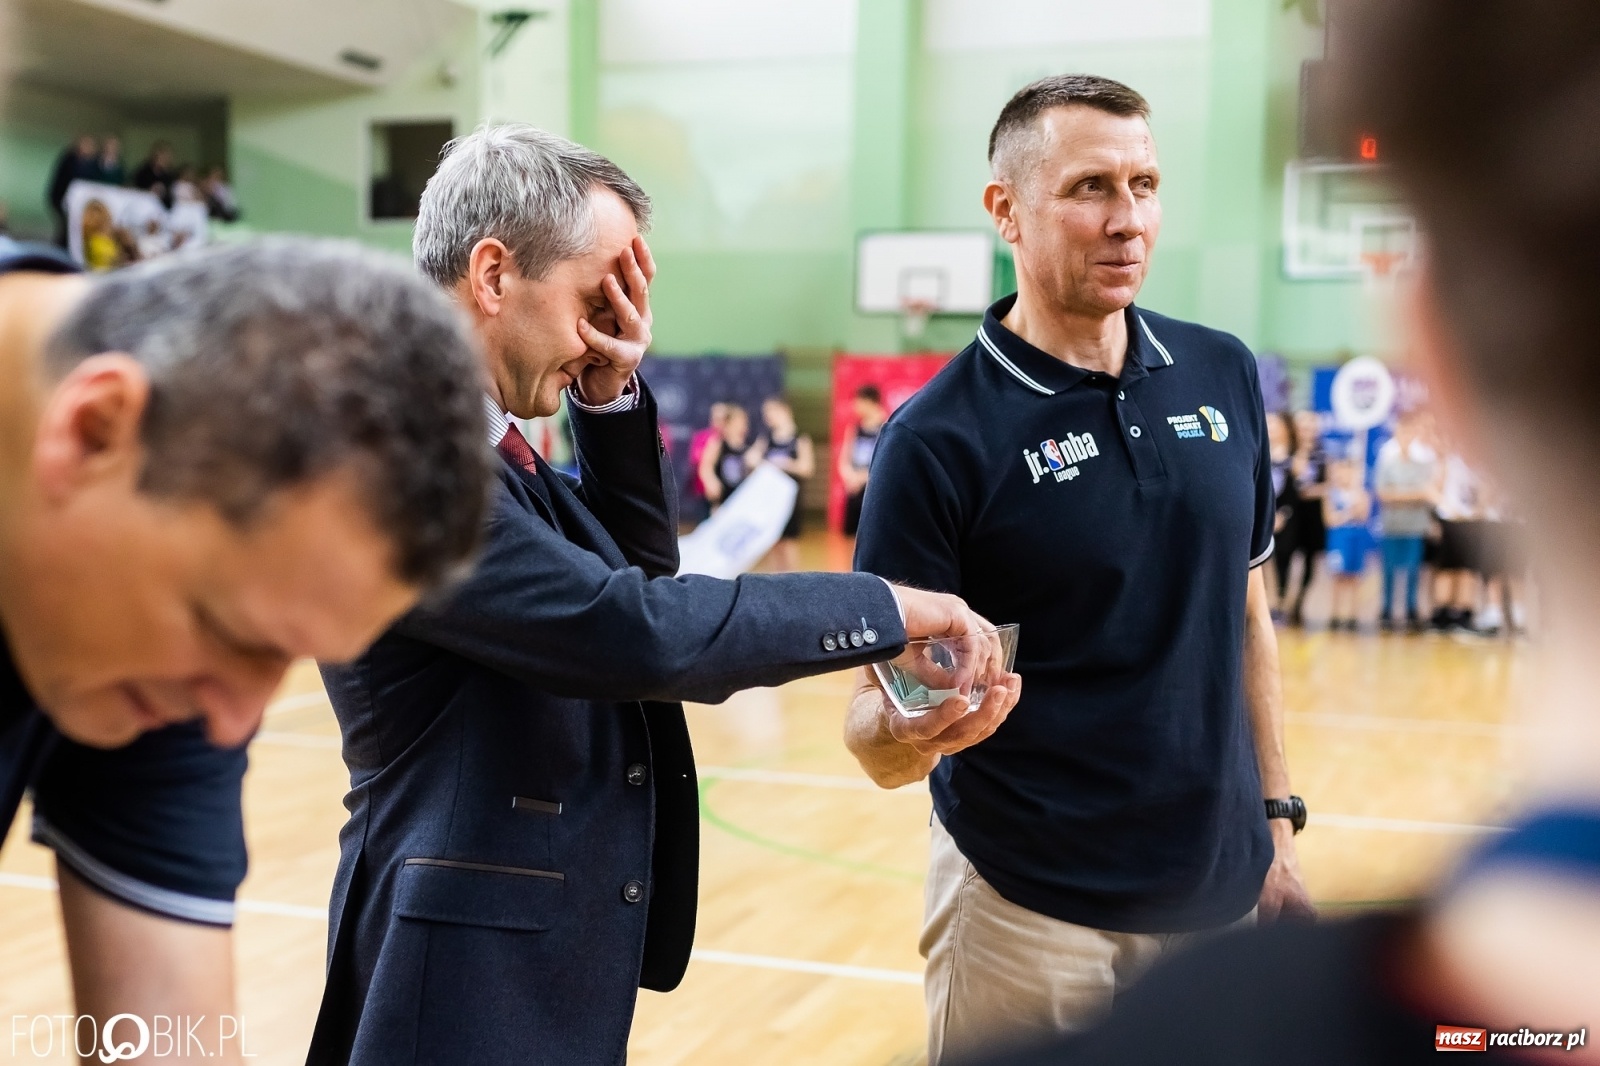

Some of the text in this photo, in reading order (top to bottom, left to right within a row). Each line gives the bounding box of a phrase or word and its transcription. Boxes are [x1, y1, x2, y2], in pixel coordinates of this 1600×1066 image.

[1166, 414, 1198, 425] PROJEKT
[1173, 421, 1202, 432] BASKET
[1176, 429, 1206, 439] POLSKA
[1023, 432, 1100, 484] jr. nba
[1053, 465, 1080, 483] League
